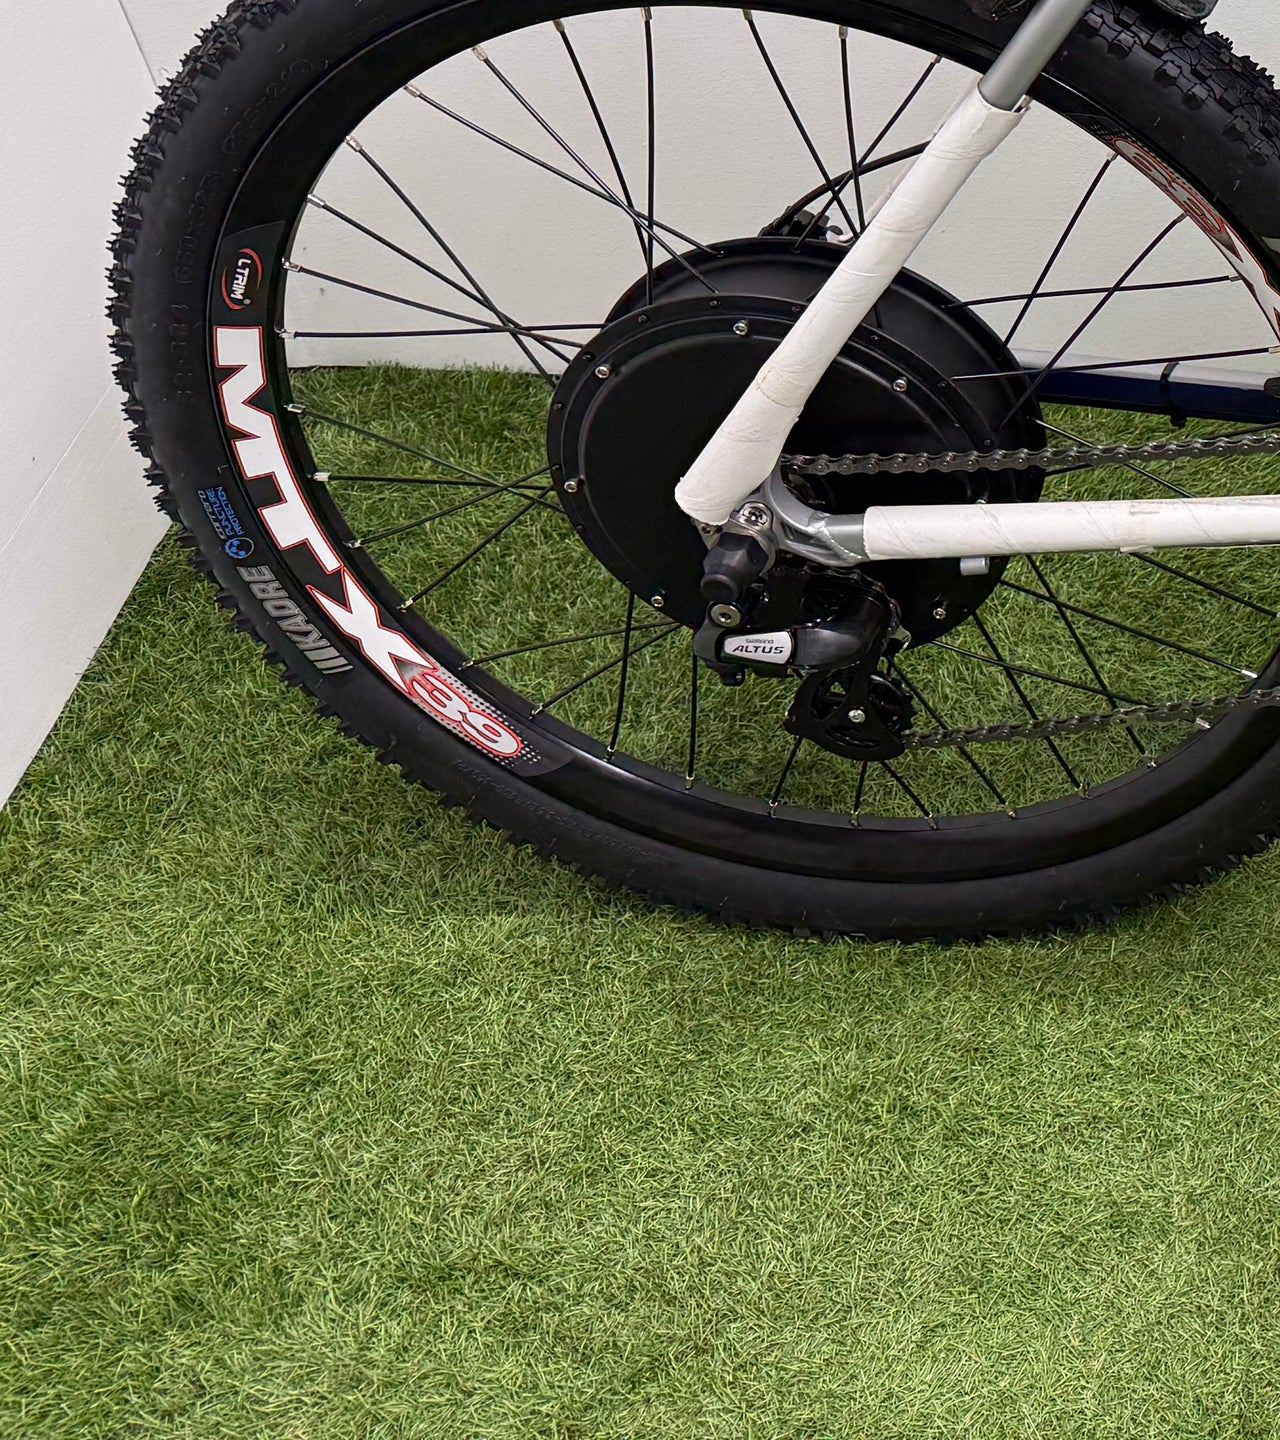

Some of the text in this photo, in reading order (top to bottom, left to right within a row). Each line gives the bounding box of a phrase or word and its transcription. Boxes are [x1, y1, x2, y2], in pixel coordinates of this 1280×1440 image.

[213, 325, 438, 698] MTX
[236, 564, 331, 651] KADRE
[733, 645, 784, 654] ALTUS
[411, 670, 525, 758] 39
